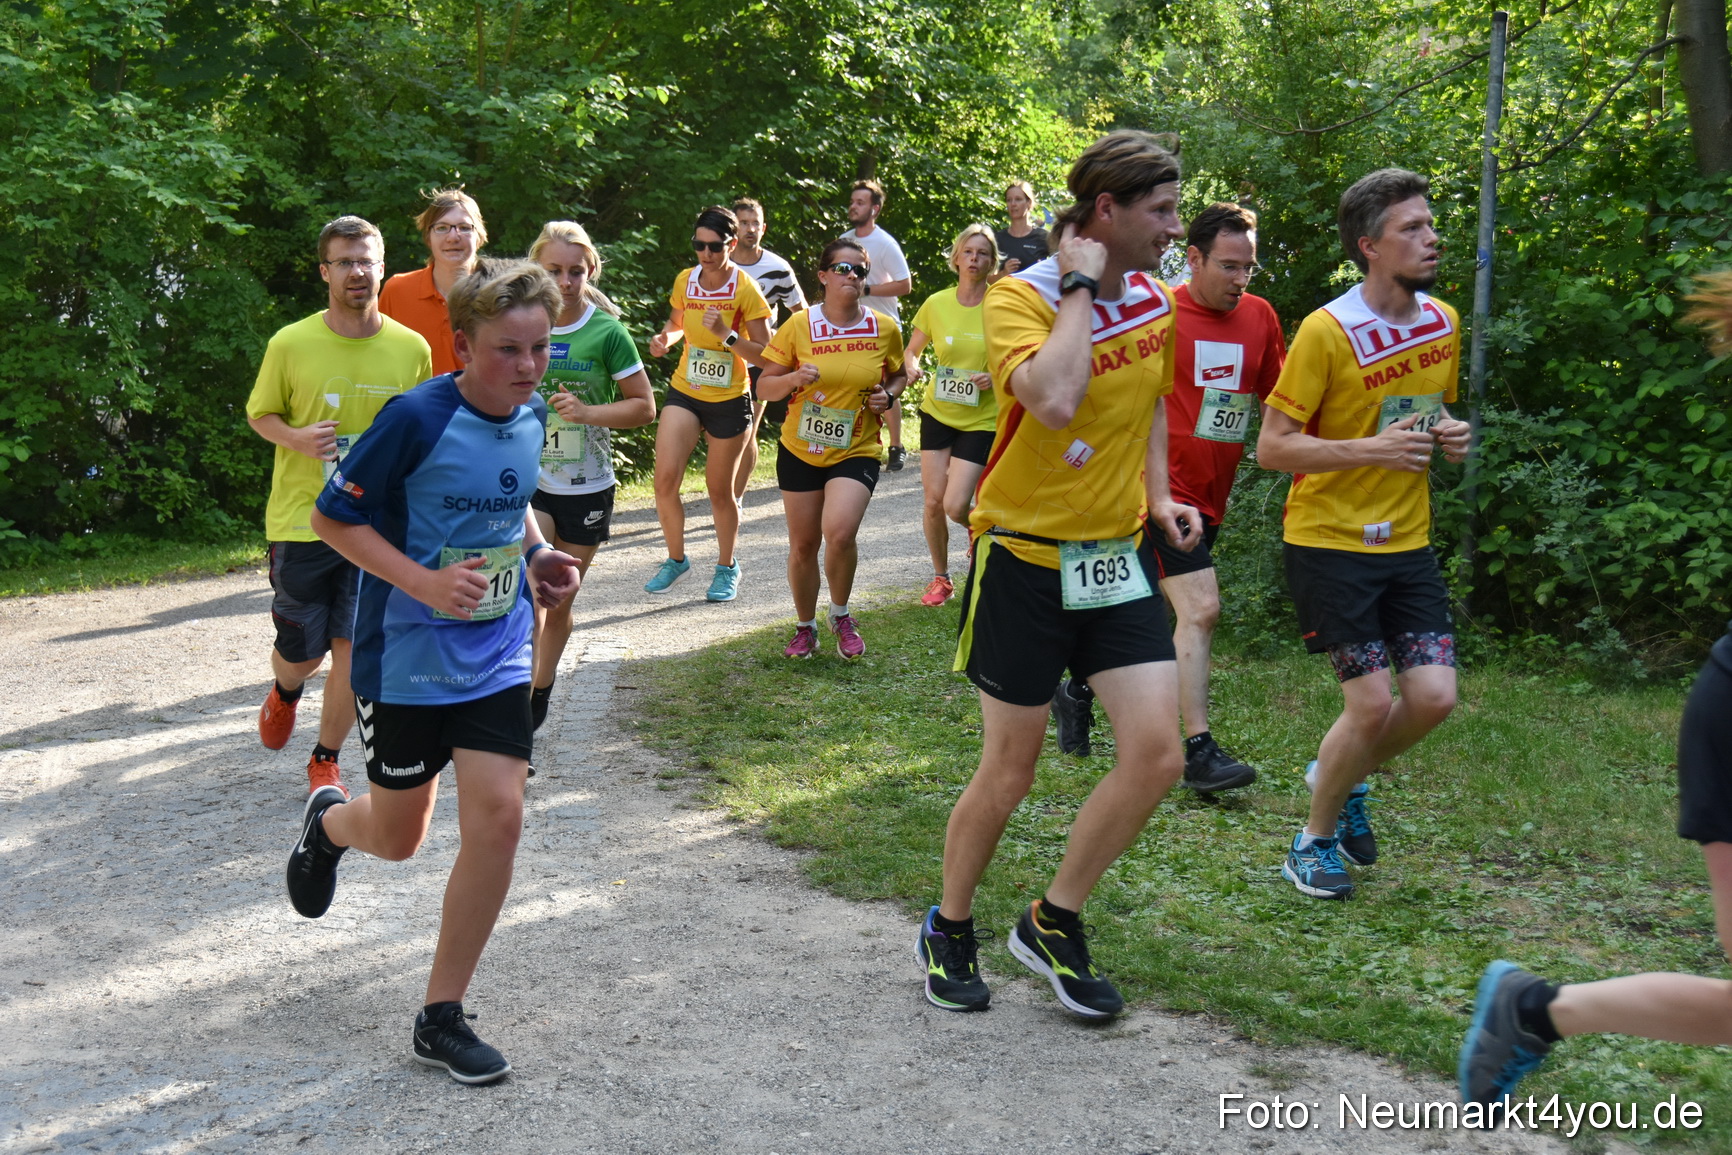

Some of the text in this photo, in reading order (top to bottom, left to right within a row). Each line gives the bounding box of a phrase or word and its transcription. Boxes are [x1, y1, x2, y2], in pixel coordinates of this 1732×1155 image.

[812, 340, 880, 356] MAX BÖGL
[692, 360, 726, 378] 1680
[1362, 359, 1413, 391] MAX
[941, 379, 974, 396] 1260
[805, 416, 845, 438] 1686
[1213, 409, 1244, 430] 507
[487, 520, 512, 531] TEAM
[1074, 555, 1131, 588] 1693
[382, 760, 425, 777] hummel
